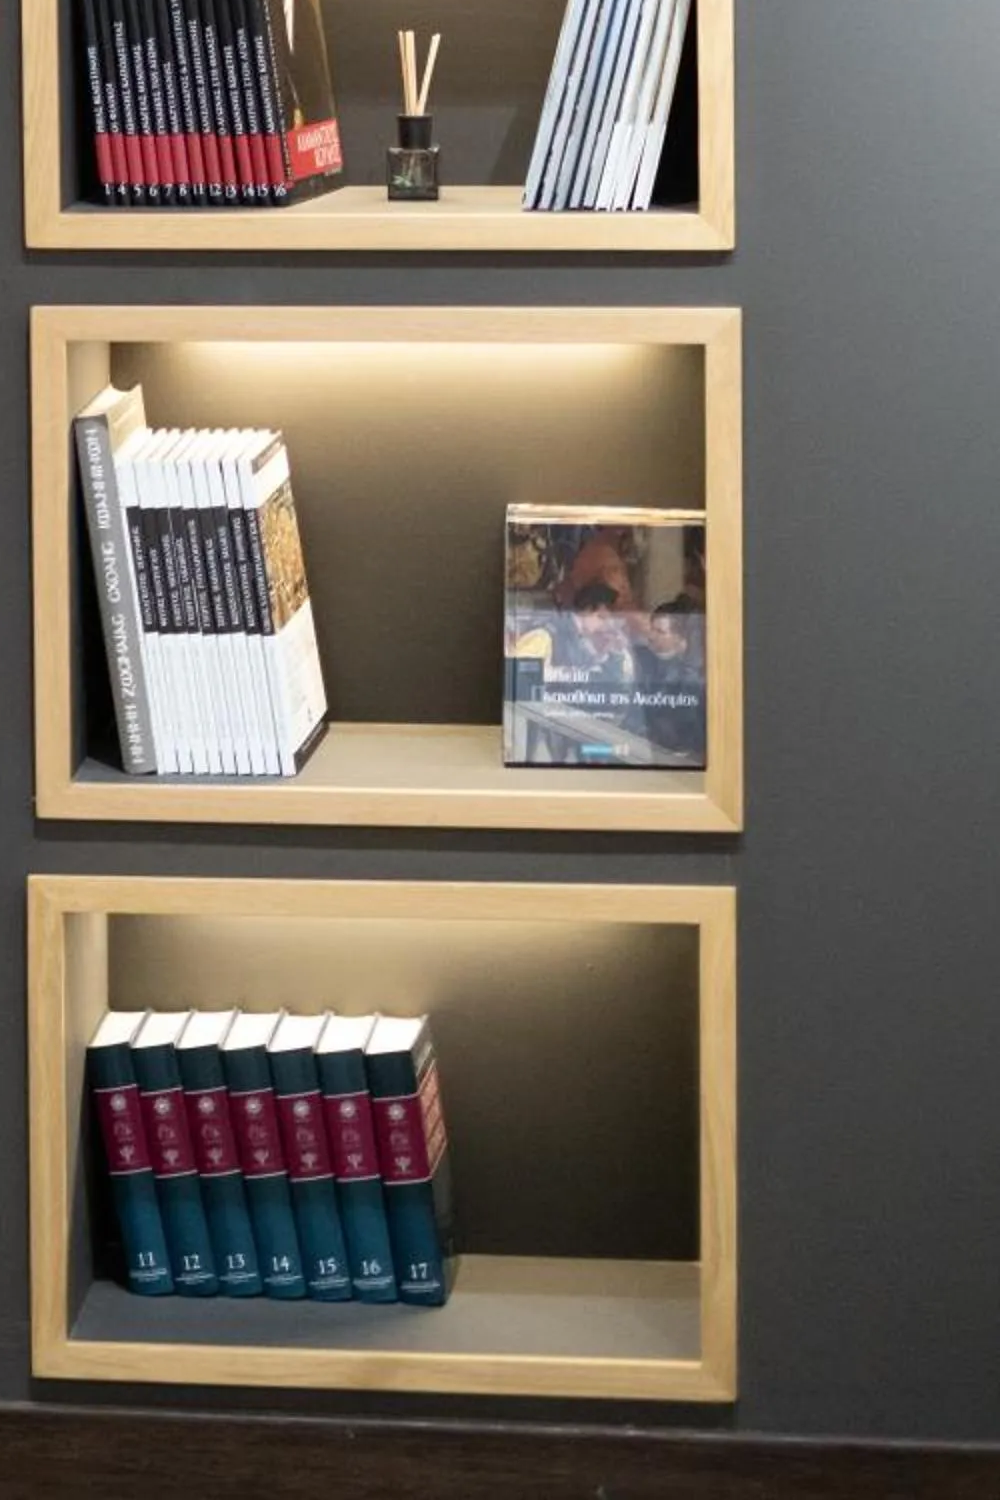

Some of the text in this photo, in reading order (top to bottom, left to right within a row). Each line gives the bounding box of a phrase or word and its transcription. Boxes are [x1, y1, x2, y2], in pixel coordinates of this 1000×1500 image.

[137, 1251, 156, 1267] 11
[183, 1253, 201, 1270] 12
[227, 1253, 246, 1269] 13
[272, 1255, 290, 1272] 14
[319, 1257, 338, 1275] 15
[362, 1258, 382, 1276] 16
[411, 1262, 428, 1279] 17
